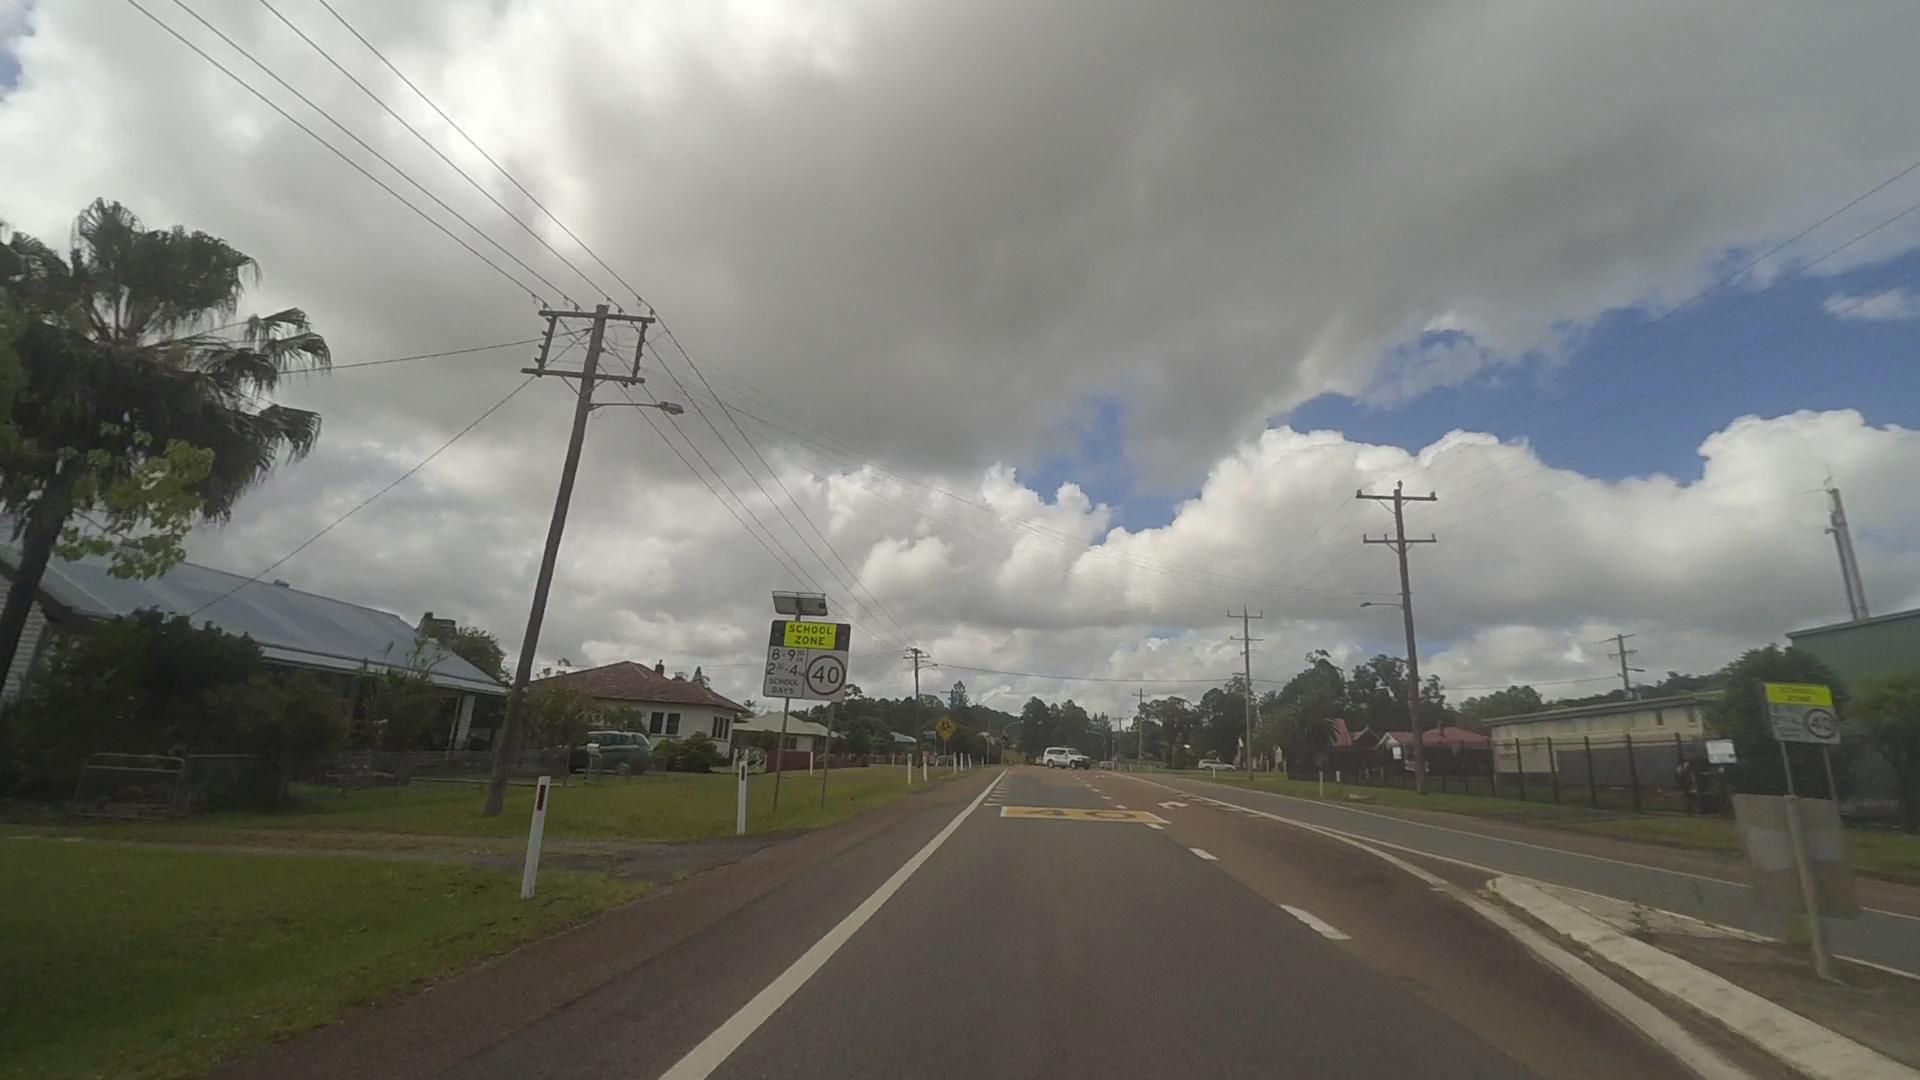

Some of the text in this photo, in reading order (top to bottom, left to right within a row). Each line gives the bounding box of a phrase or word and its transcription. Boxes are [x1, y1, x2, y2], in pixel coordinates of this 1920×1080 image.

[788, 624, 833, 635] SCHOOL
[794, 635, 825, 646] ZONE
[811, 665, 839, 684] 40
[771, 686, 794, 695] DAYS
